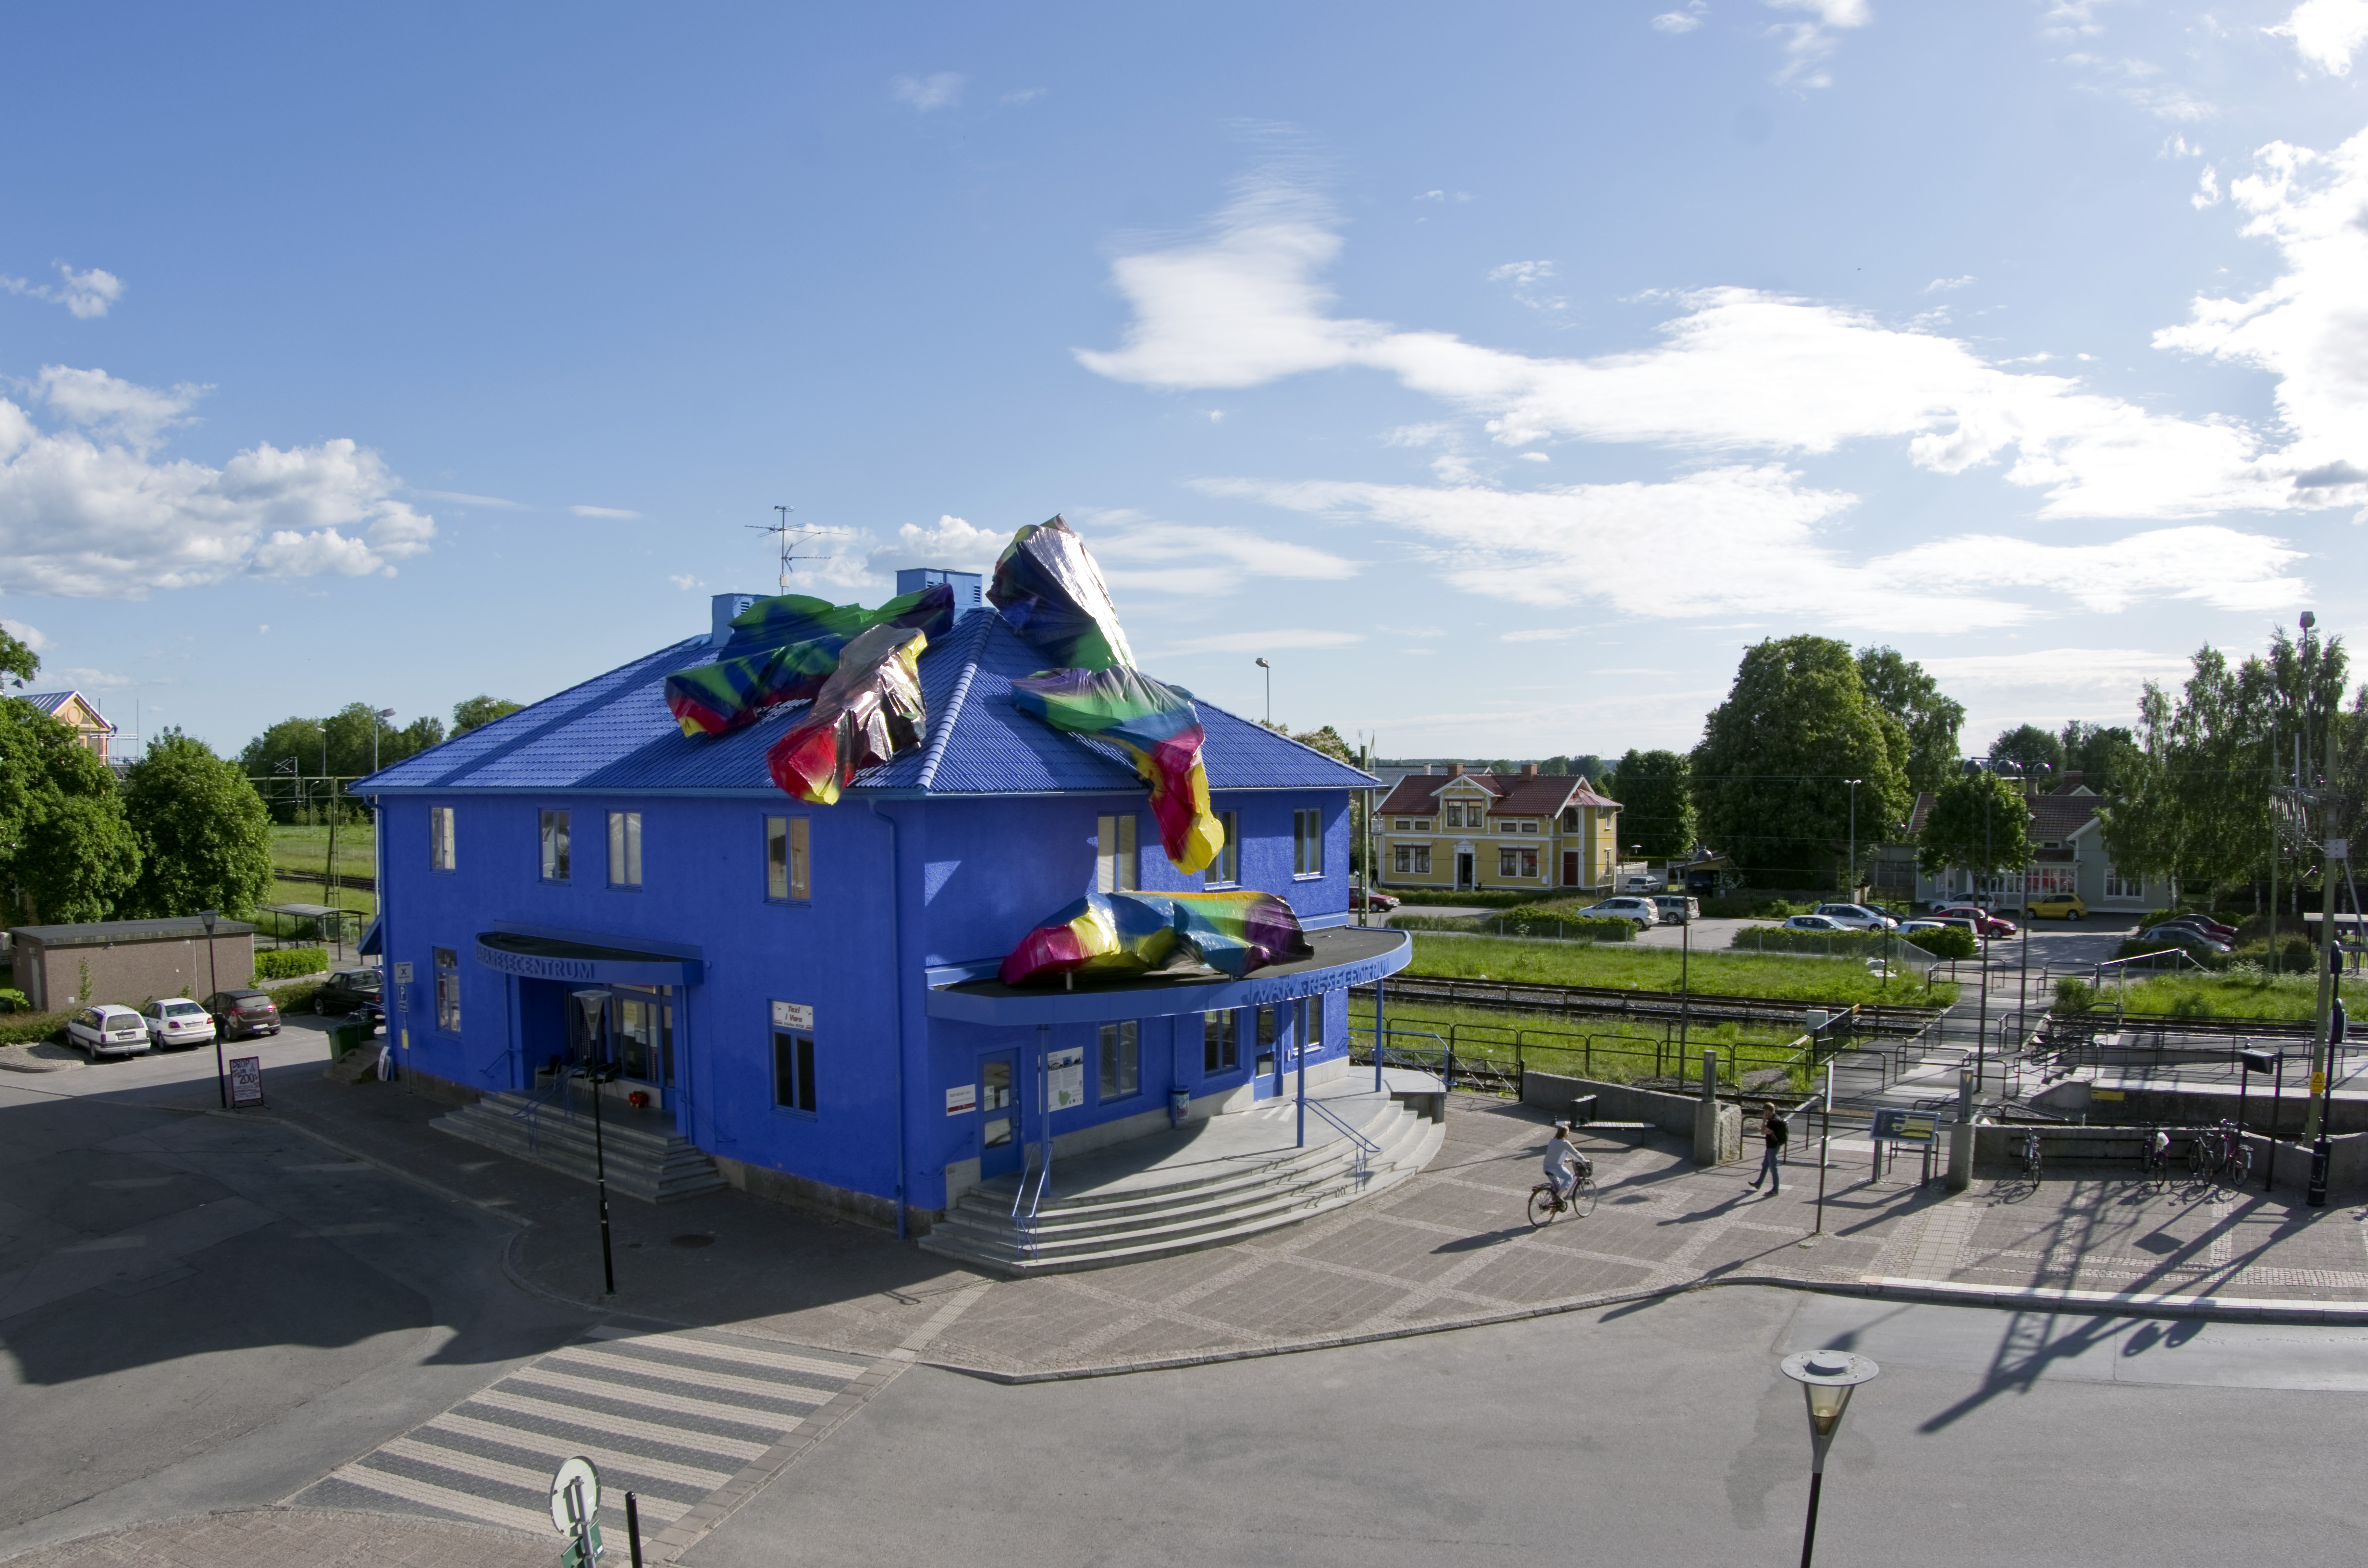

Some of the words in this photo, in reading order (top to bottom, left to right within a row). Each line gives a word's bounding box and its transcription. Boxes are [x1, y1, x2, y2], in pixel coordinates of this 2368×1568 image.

[491, 951, 594, 979] RESECENTRUM
[1257, 978, 1305, 1002] VARA
[1307, 958, 1390, 994] RESECENTRUM
[400, 986, 405, 1000] P
[233, 1060, 250, 1068] DROP
